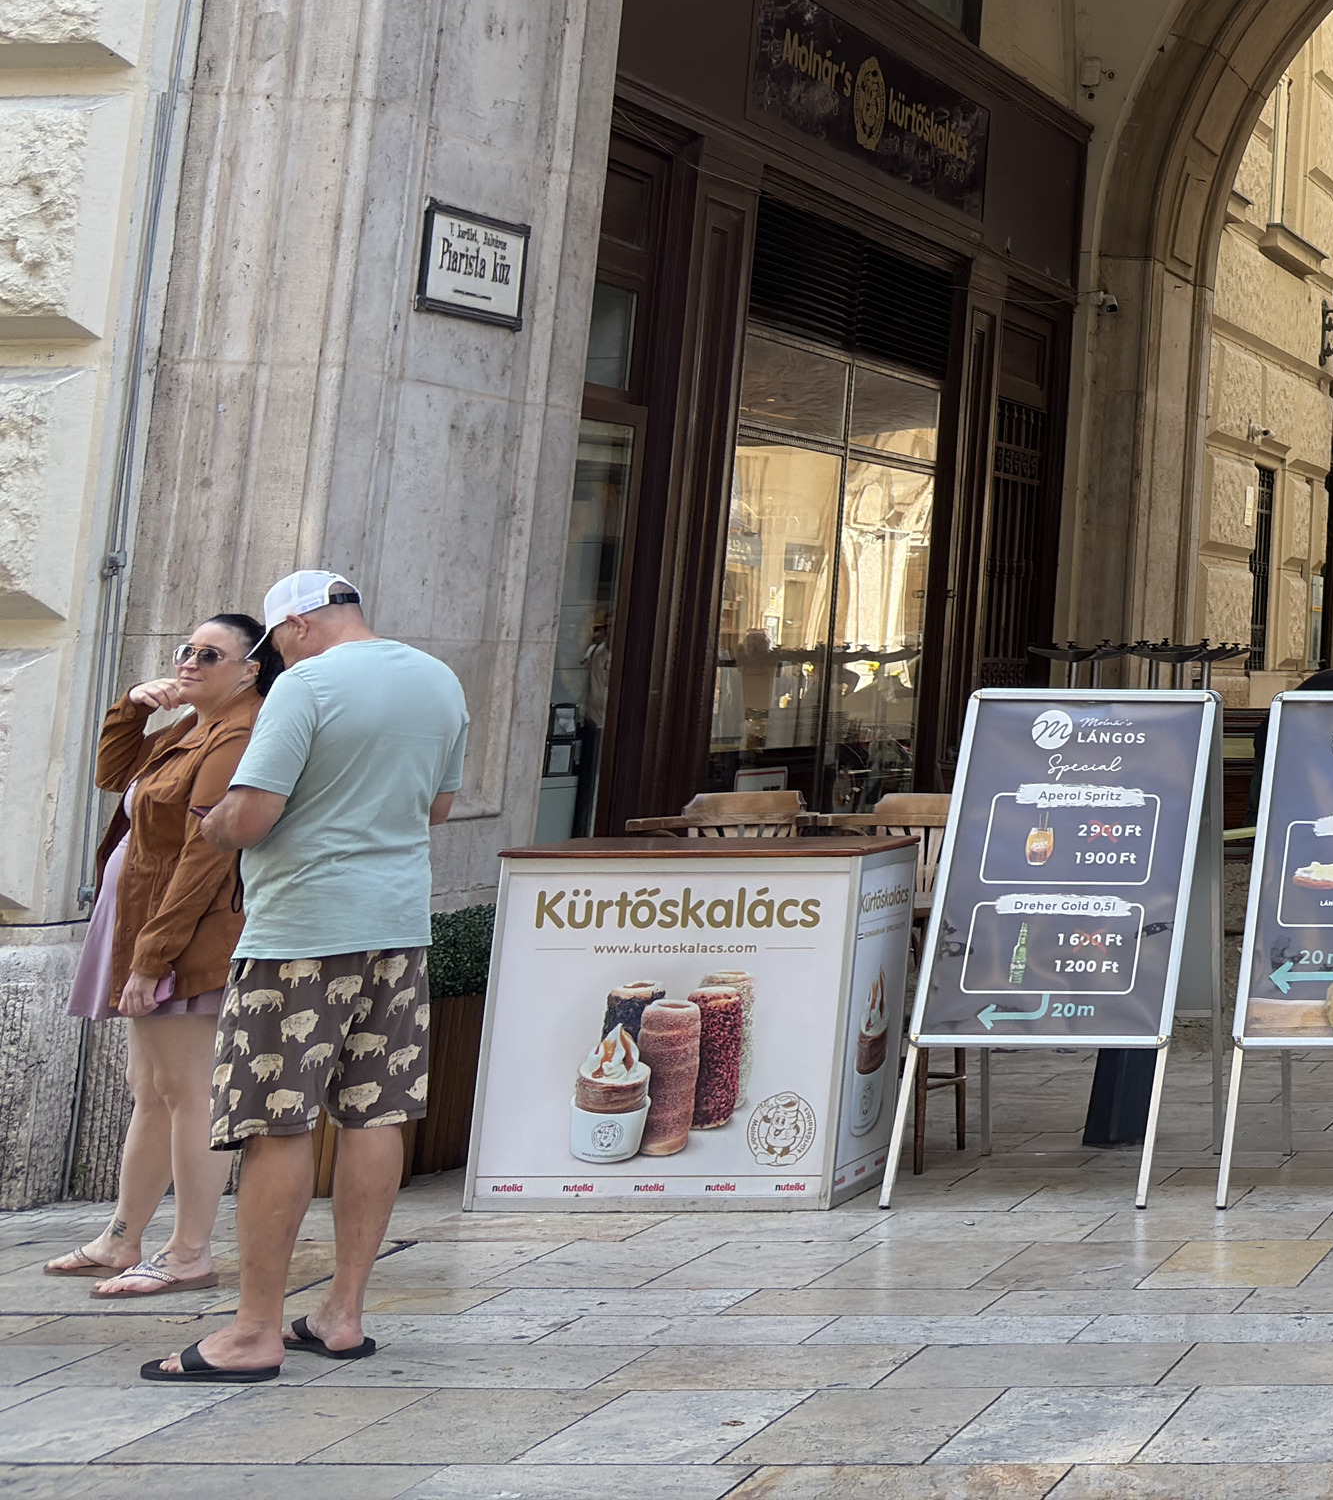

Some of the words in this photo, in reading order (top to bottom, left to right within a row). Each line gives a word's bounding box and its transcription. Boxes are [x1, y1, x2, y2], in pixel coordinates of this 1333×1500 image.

[438, 237, 487, 279] Piarista
[490, 251, 511, 286] köz
[1077, 729, 1146, 744] LÁNGOS
[1047, 753, 1122, 781] Special
[1038, 790, 1081, 802] Aperol
[1084, 790, 1122, 802] Spritz
[535, 887, 821, 930] Kürtőskalács
[1013, 900, 1058, 911] Dreher
[1061, 901, 1090, 911] Gold
[594, 943, 758, 954] www.kurtoskalacs.com
[1101, 960, 1119, 973] Ft
[492, 1182, 523, 1193] nutella
[562, 1182, 594, 1193] nutella
[634, 1182, 665, 1193] nutella
[705, 1182, 736, 1193] nutella
[775, 1182, 806, 1193] nutella
